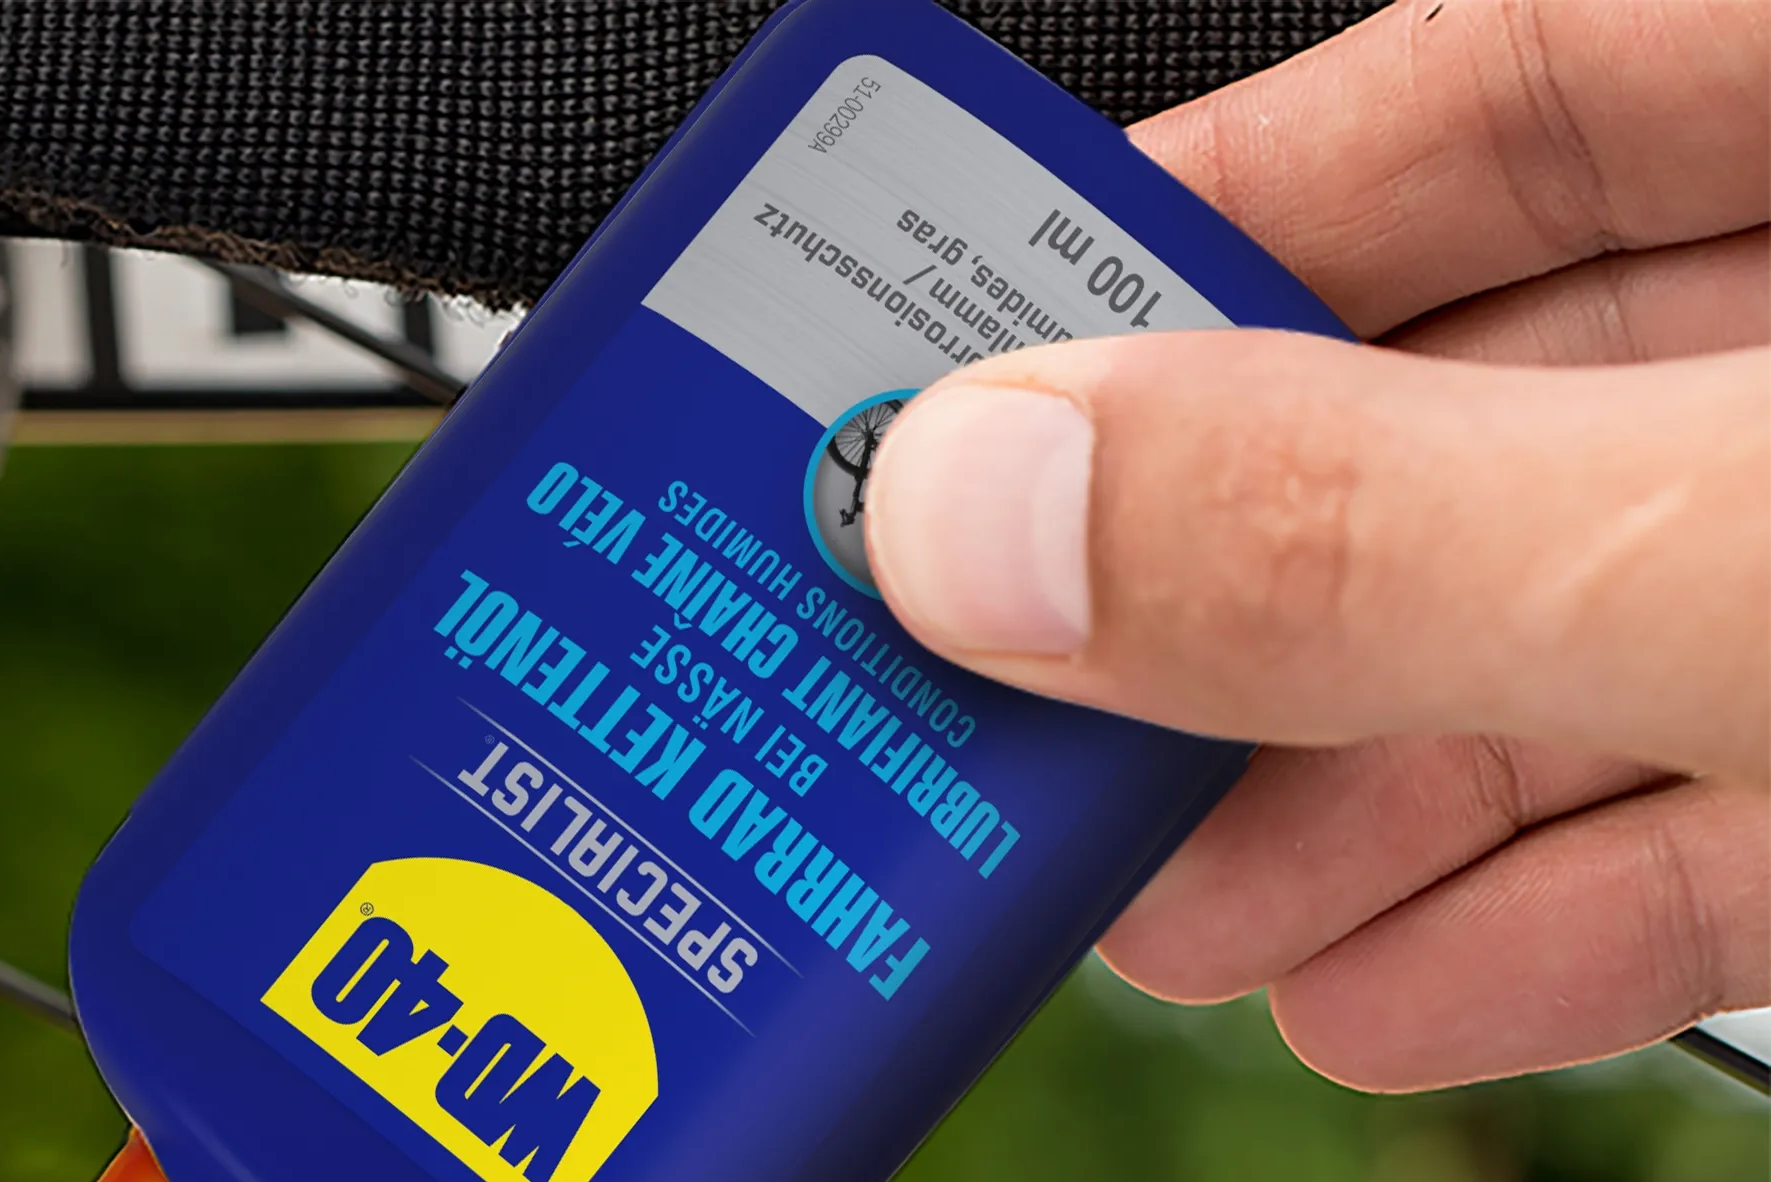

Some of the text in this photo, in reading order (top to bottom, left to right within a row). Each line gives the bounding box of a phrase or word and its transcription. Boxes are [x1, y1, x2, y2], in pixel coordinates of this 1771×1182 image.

[807, 76, 881, 154] 51-00299A
[754, 203, 984, 365] rrosionsschutz
[897, 210, 1073, 342] umides, gras
[929, 278, 1026, 353] lamm
[1028, 209, 1161, 327] 100 ml
[527, 462, 1020, 878] LUBRIFIANT CHAÎNE VÉLO
[658, 481, 974, 747] CONDITIONS HUMIDES
[434, 569, 930, 1000] FAHRRAD KETTENÖL
[630, 625, 828, 797] BEI NÄSSE
[458, 743, 757, 992] SPECIALIST
